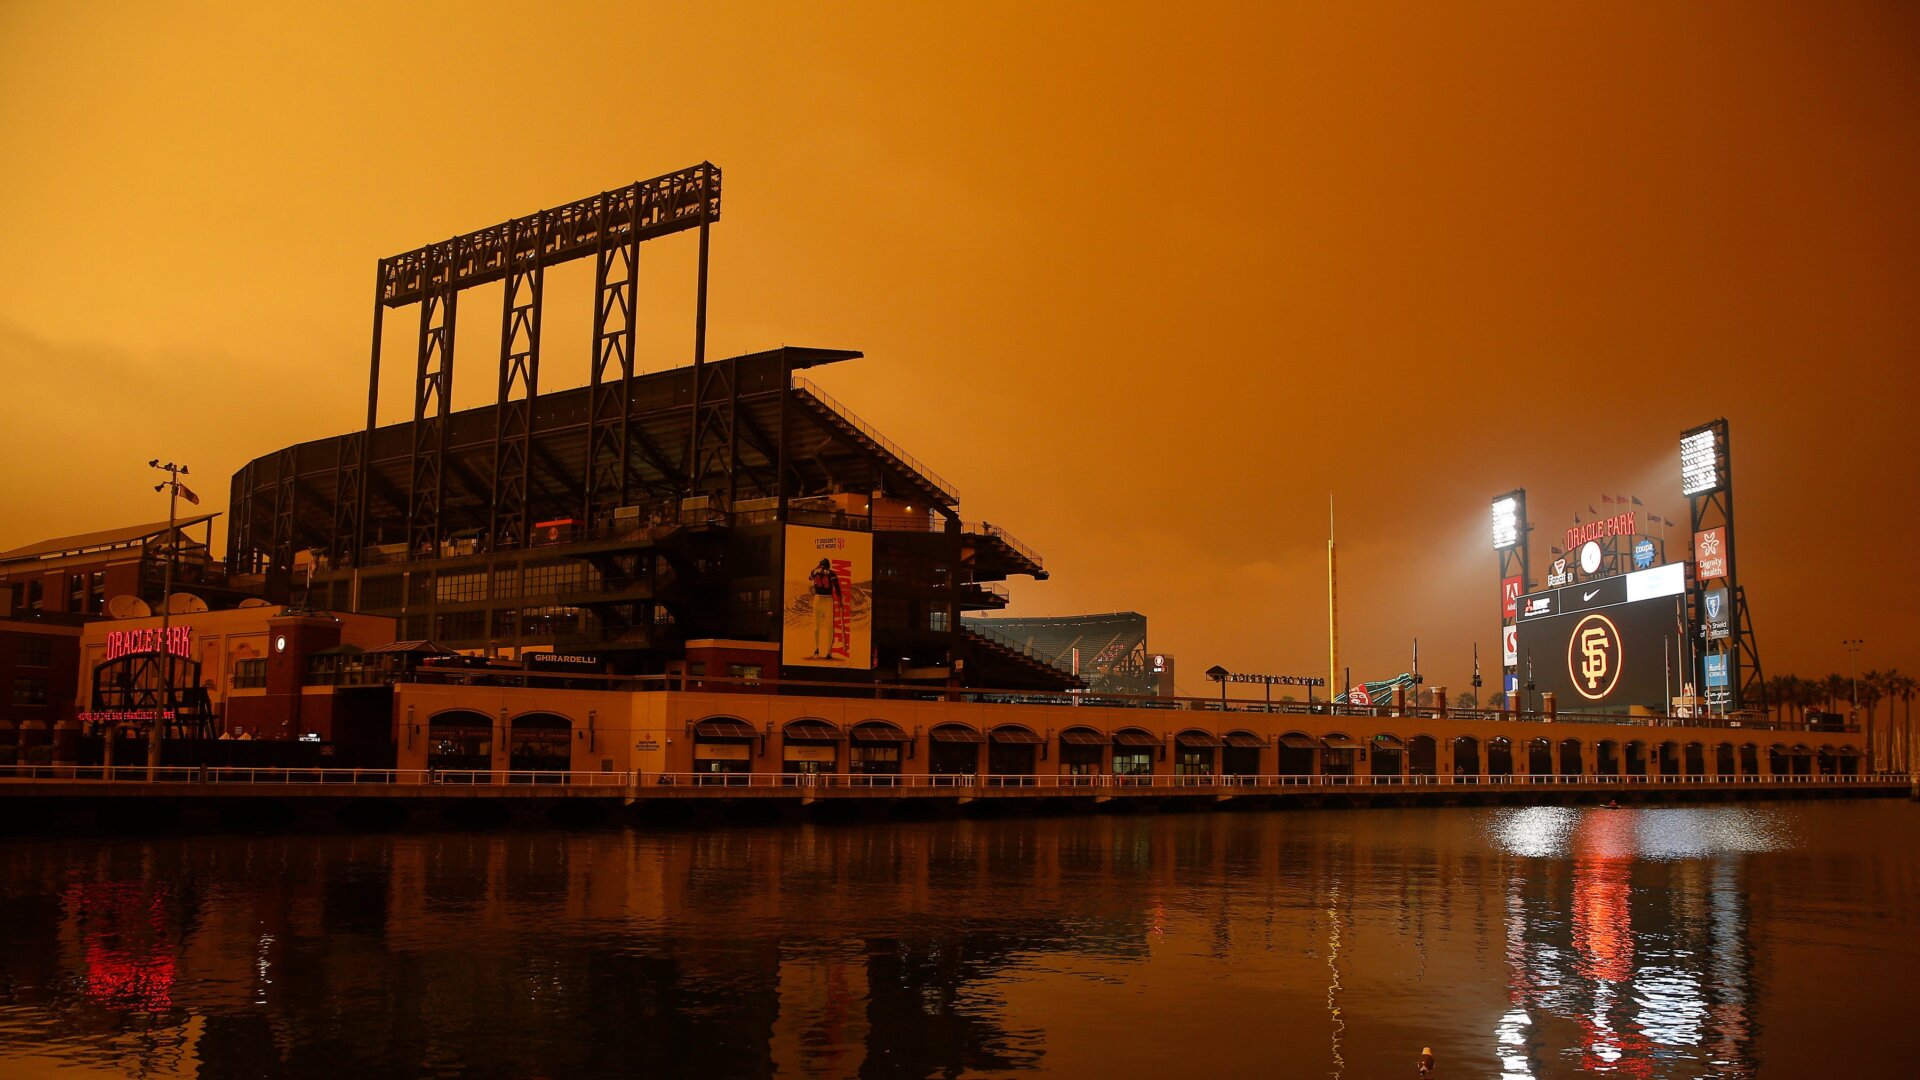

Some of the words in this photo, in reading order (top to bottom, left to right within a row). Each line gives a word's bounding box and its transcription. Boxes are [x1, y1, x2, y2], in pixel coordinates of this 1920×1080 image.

[1567, 519, 1604, 552] ORACLE
[1606, 511, 1636, 538] PARK
[1635, 543, 1654, 554] coupa
[1700, 558, 1722, 570] Dignity
[1701, 567, 1722, 578] Health
[1712, 621, 1727, 630] Shield
[107, 628, 154, 661] ORACLE
[534, 654, 597, 664] GHIRARDELLI
[1581, 627, 1610, 689] SF
